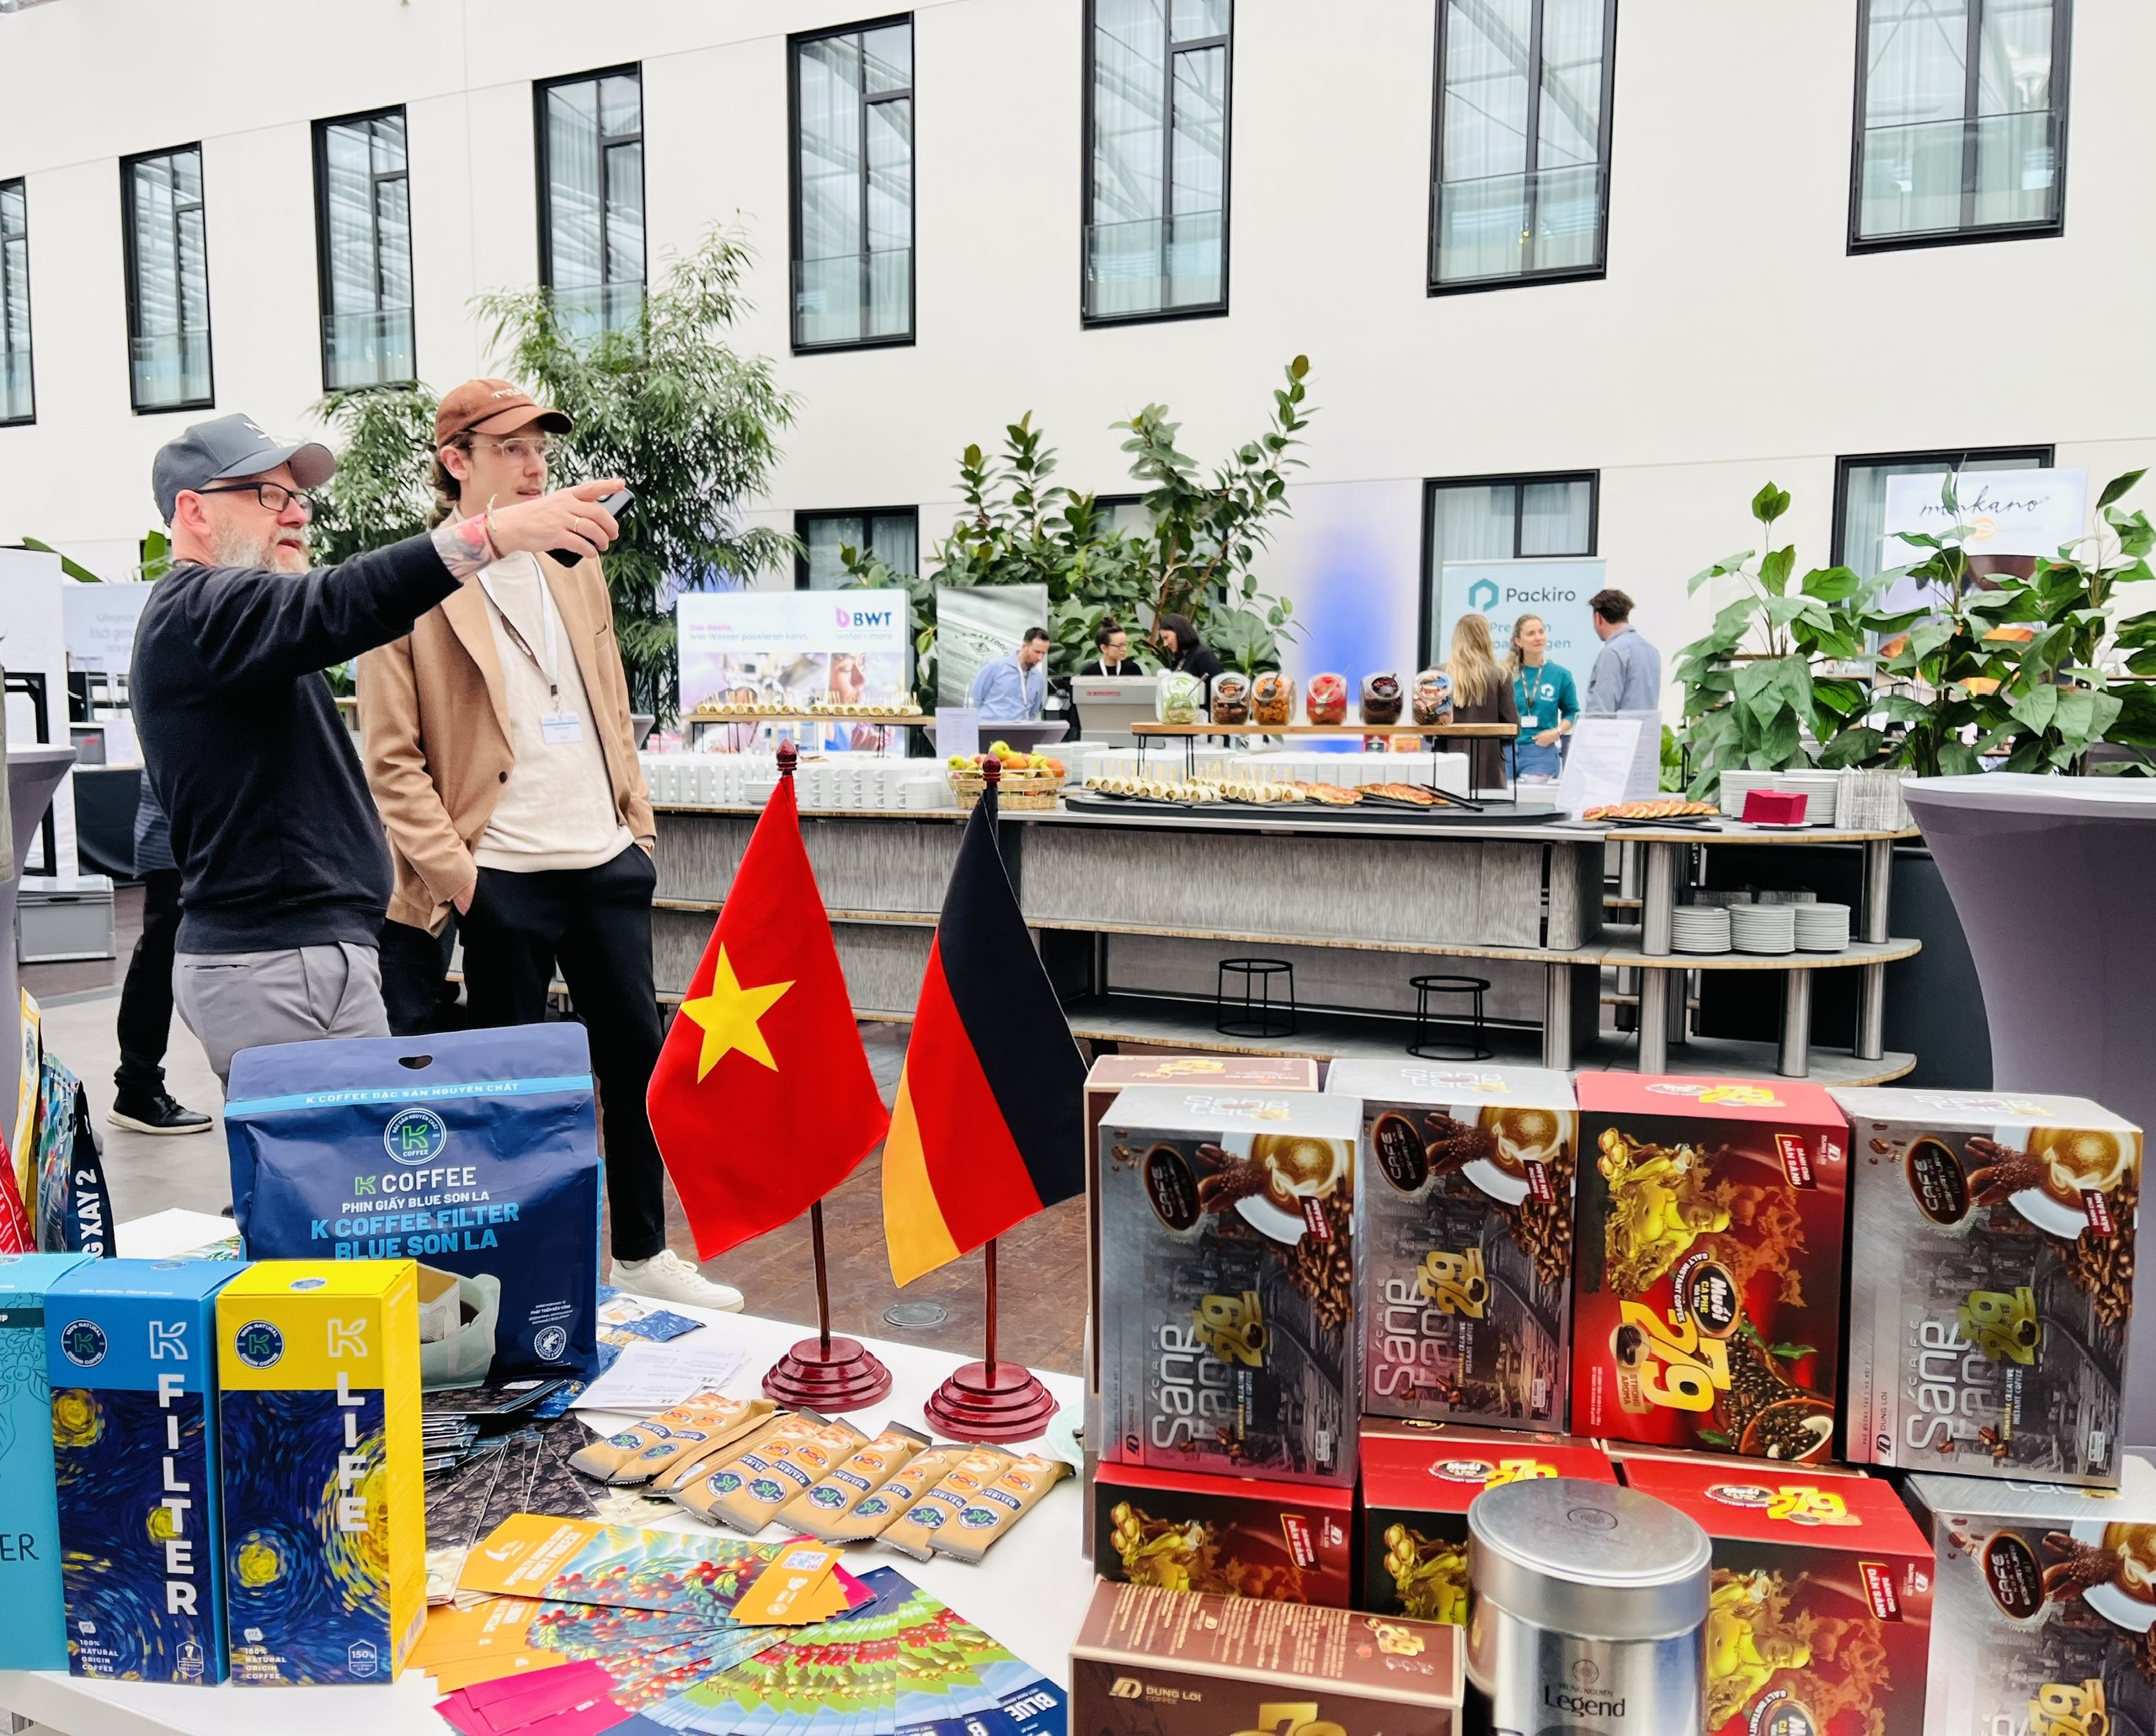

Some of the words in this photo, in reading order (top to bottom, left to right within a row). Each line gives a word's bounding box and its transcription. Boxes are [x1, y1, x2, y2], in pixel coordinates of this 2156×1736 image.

[1506, 587, 1576, 602] Packiro
[853, 612, 892, 627] BWT
[690, 633, 707, 641] was
[709, 632, 739, 640] Wasser
[741, 633, 784, 643] passieren
[786, 631, 808, 641] kann.
[318, 1093, 367, 1103] COFFEE
[1380, 1131, 1402, 1179] CAFE
[75, 1168, 97, 1184] 2
[355, 1176, 376, 1195] K
[382, 1167, 477, 1194] COFFEE
[1801, 1166, 1810, 1181] CHO
[1913, 1159, 1940, 1210] CAFE
[1931, 1148, 1956, 1211] SIGNATURE
[342, 1200, 373, 1213] PHIN
[408, 1194, 441, 1208] BLUE
[443, 1192, 470, 1203] SON
[472, 1191, 490, 1201] LA
[1150, 1165, 1174, 1218] CAFE
[77, 1192, 104, 1237] XAY
[311, 1219, 329, 1240] K
[335, 1211, 432, 1237] COFFEE
[436, 1202, 520, 1229] FILTER
[334, 1237, 402, 1261] BLUE
[407, 1232, 459, 1256] SON
[464, 1229, 499, 1250] LA
[1684, 1253, 1709, 1265] SALT
[1417, 1247, 1489, 1319] 279
[1673, 1263, 1689, 1294] INSTANT
[1673, 1294, 1686, 1323] COFFEE
[1710, 1277, 1732, 1322] Muối
[78, 1322, 102, 1338] NATURAL
[149, 1321, 188, 1359] K
[253, 1324, 278, 1338] NATURAL
[328, 1319, 368, 1358] K
[1193, 1293, 1265, 1367] 279
[1957, 1286, 2041, 1365] 279
[1620, 1301, 1731, 1412] 279
[1621, 1375, 1630, 1405] AROMA
[1630, 1374, 1641, 1407] STRONG
[2005, 1368, 2014, 1402] CREATIVE
[2013, 1396, 2021, 1424] INSTANT
[337, 1372, 369, 1532] LIFE
[773, 1462, 806, 1484] DELIGHT
[830, 1472, 866, 1488] DELIGHT
[158, 1374, 198, 1616] FILTER
[926, 1491, 963, 1508] DELIGHT
[980, 1490, 1016, 1507] DELIGHT
[1765, 1488, 1847, 1520] 279
[1306, 1549, 1315, 1562] CHO
[1991, 1554, 2015, 1605] CAFE
[1872, 1591, 1887, 1618] SÀNH
[1886, 1598, 1896, 1612] CHO
[81, 1648, 119, 1657] NATURAL
[1003, 1691, 1058, 1722] BLUE
[1146, 1685, 1180, 1699] DUNG
[1545, 1685, 1625, 1717] Legend
[1767, 1690, 1788, 1707] SALT
[1749, 1701, 1768, 1732] INSTANT
